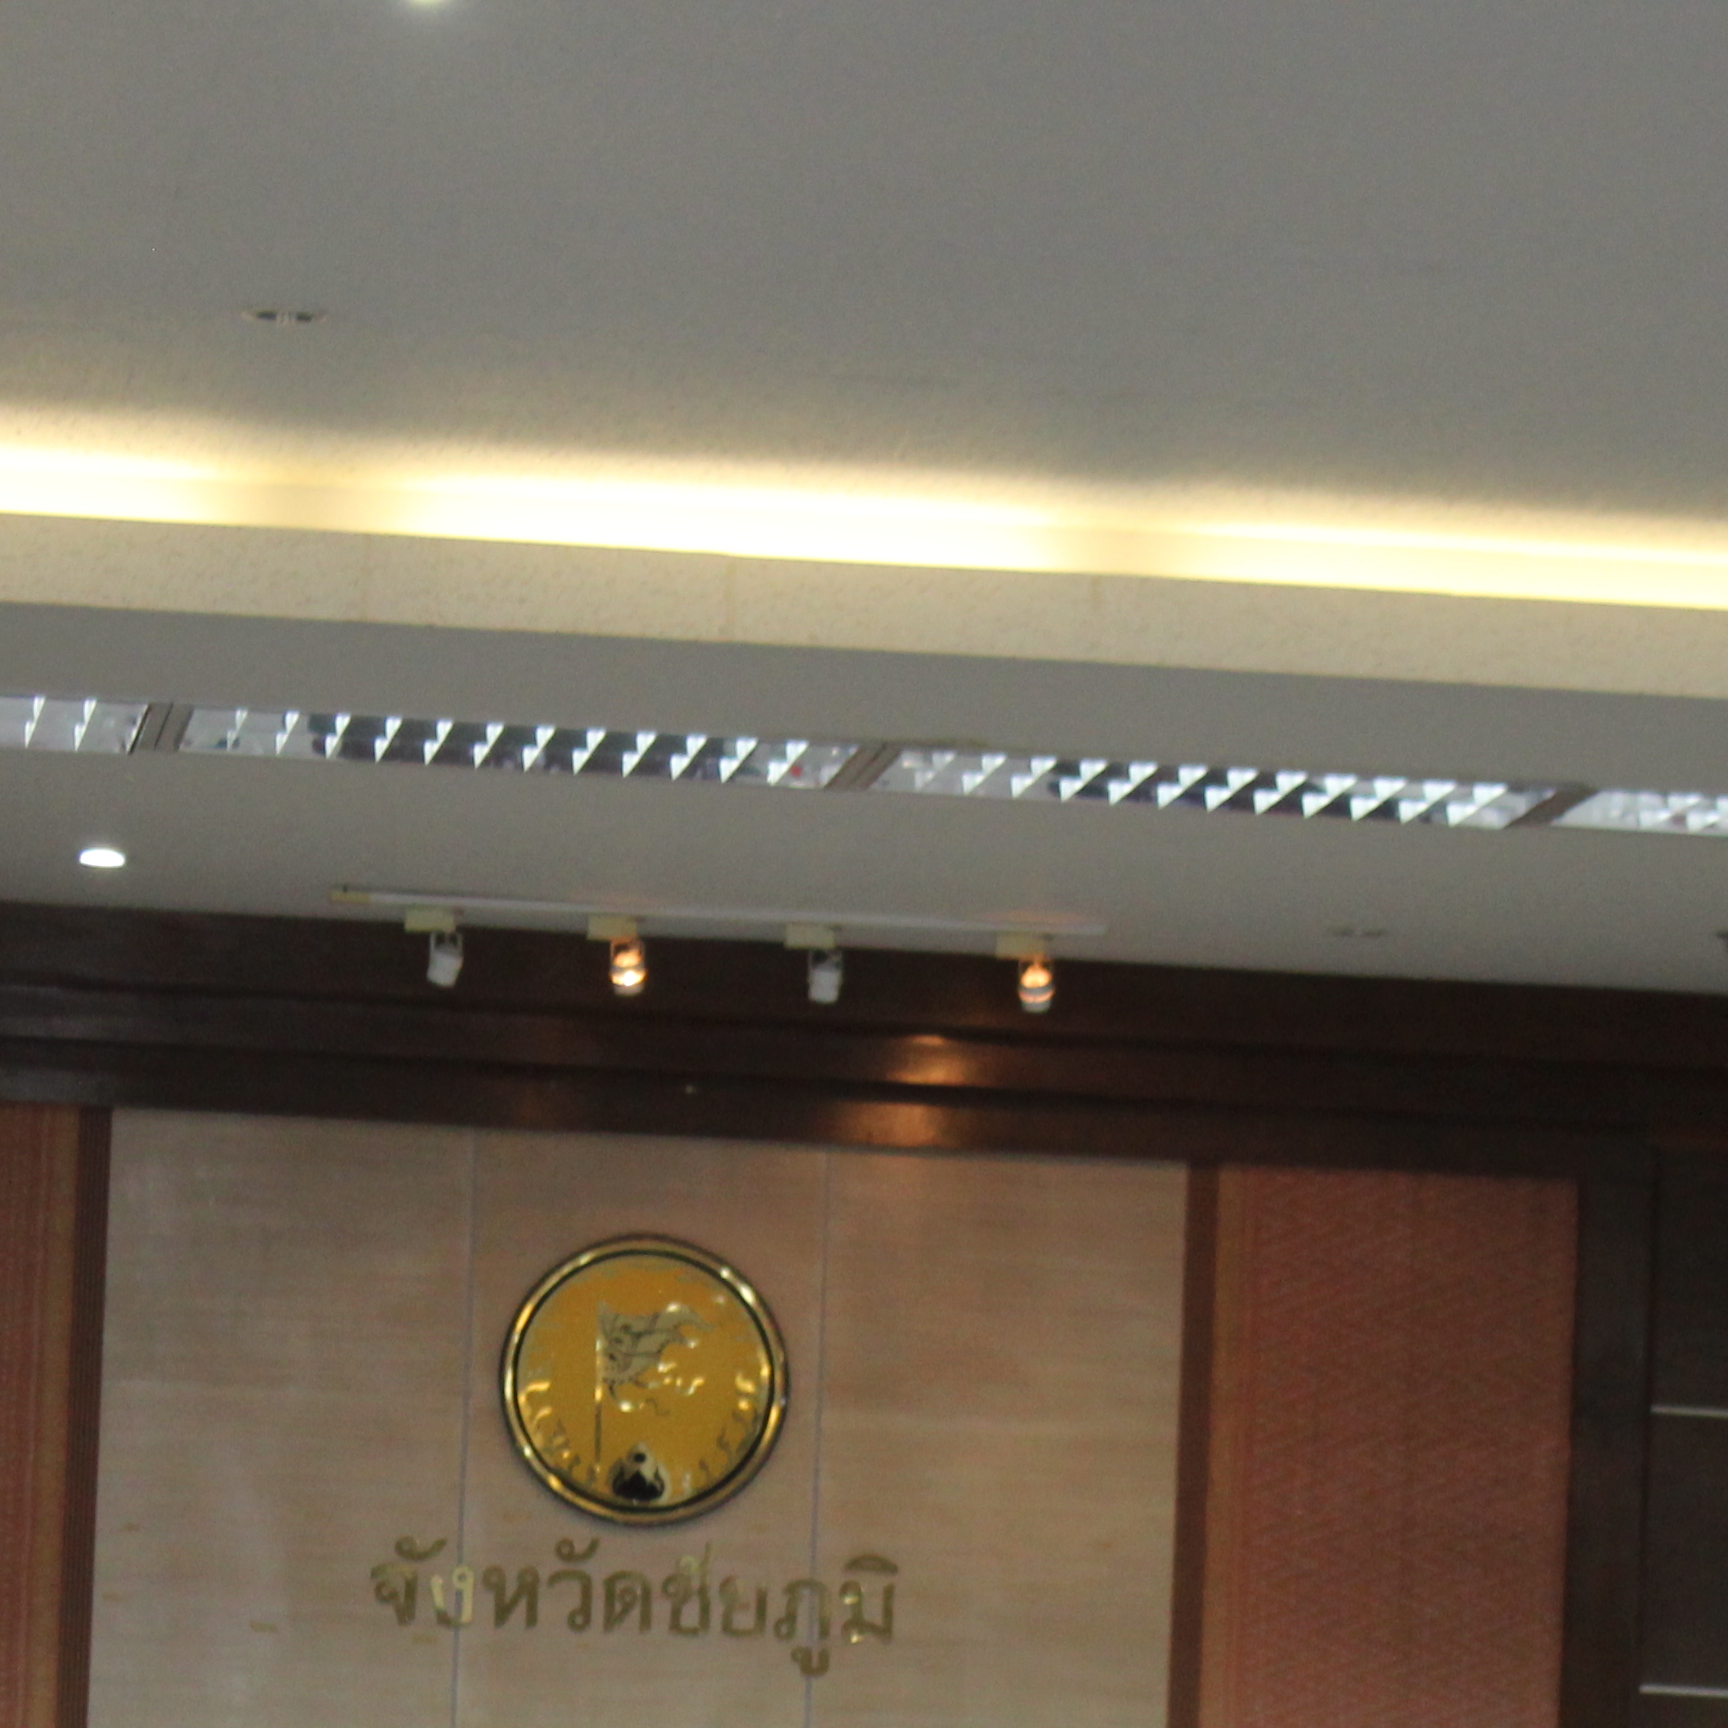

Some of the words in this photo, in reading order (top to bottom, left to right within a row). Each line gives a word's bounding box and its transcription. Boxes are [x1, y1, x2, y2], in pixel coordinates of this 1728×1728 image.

[370, 1535, 900, 1677] จังหวัดชัยภูมิ
